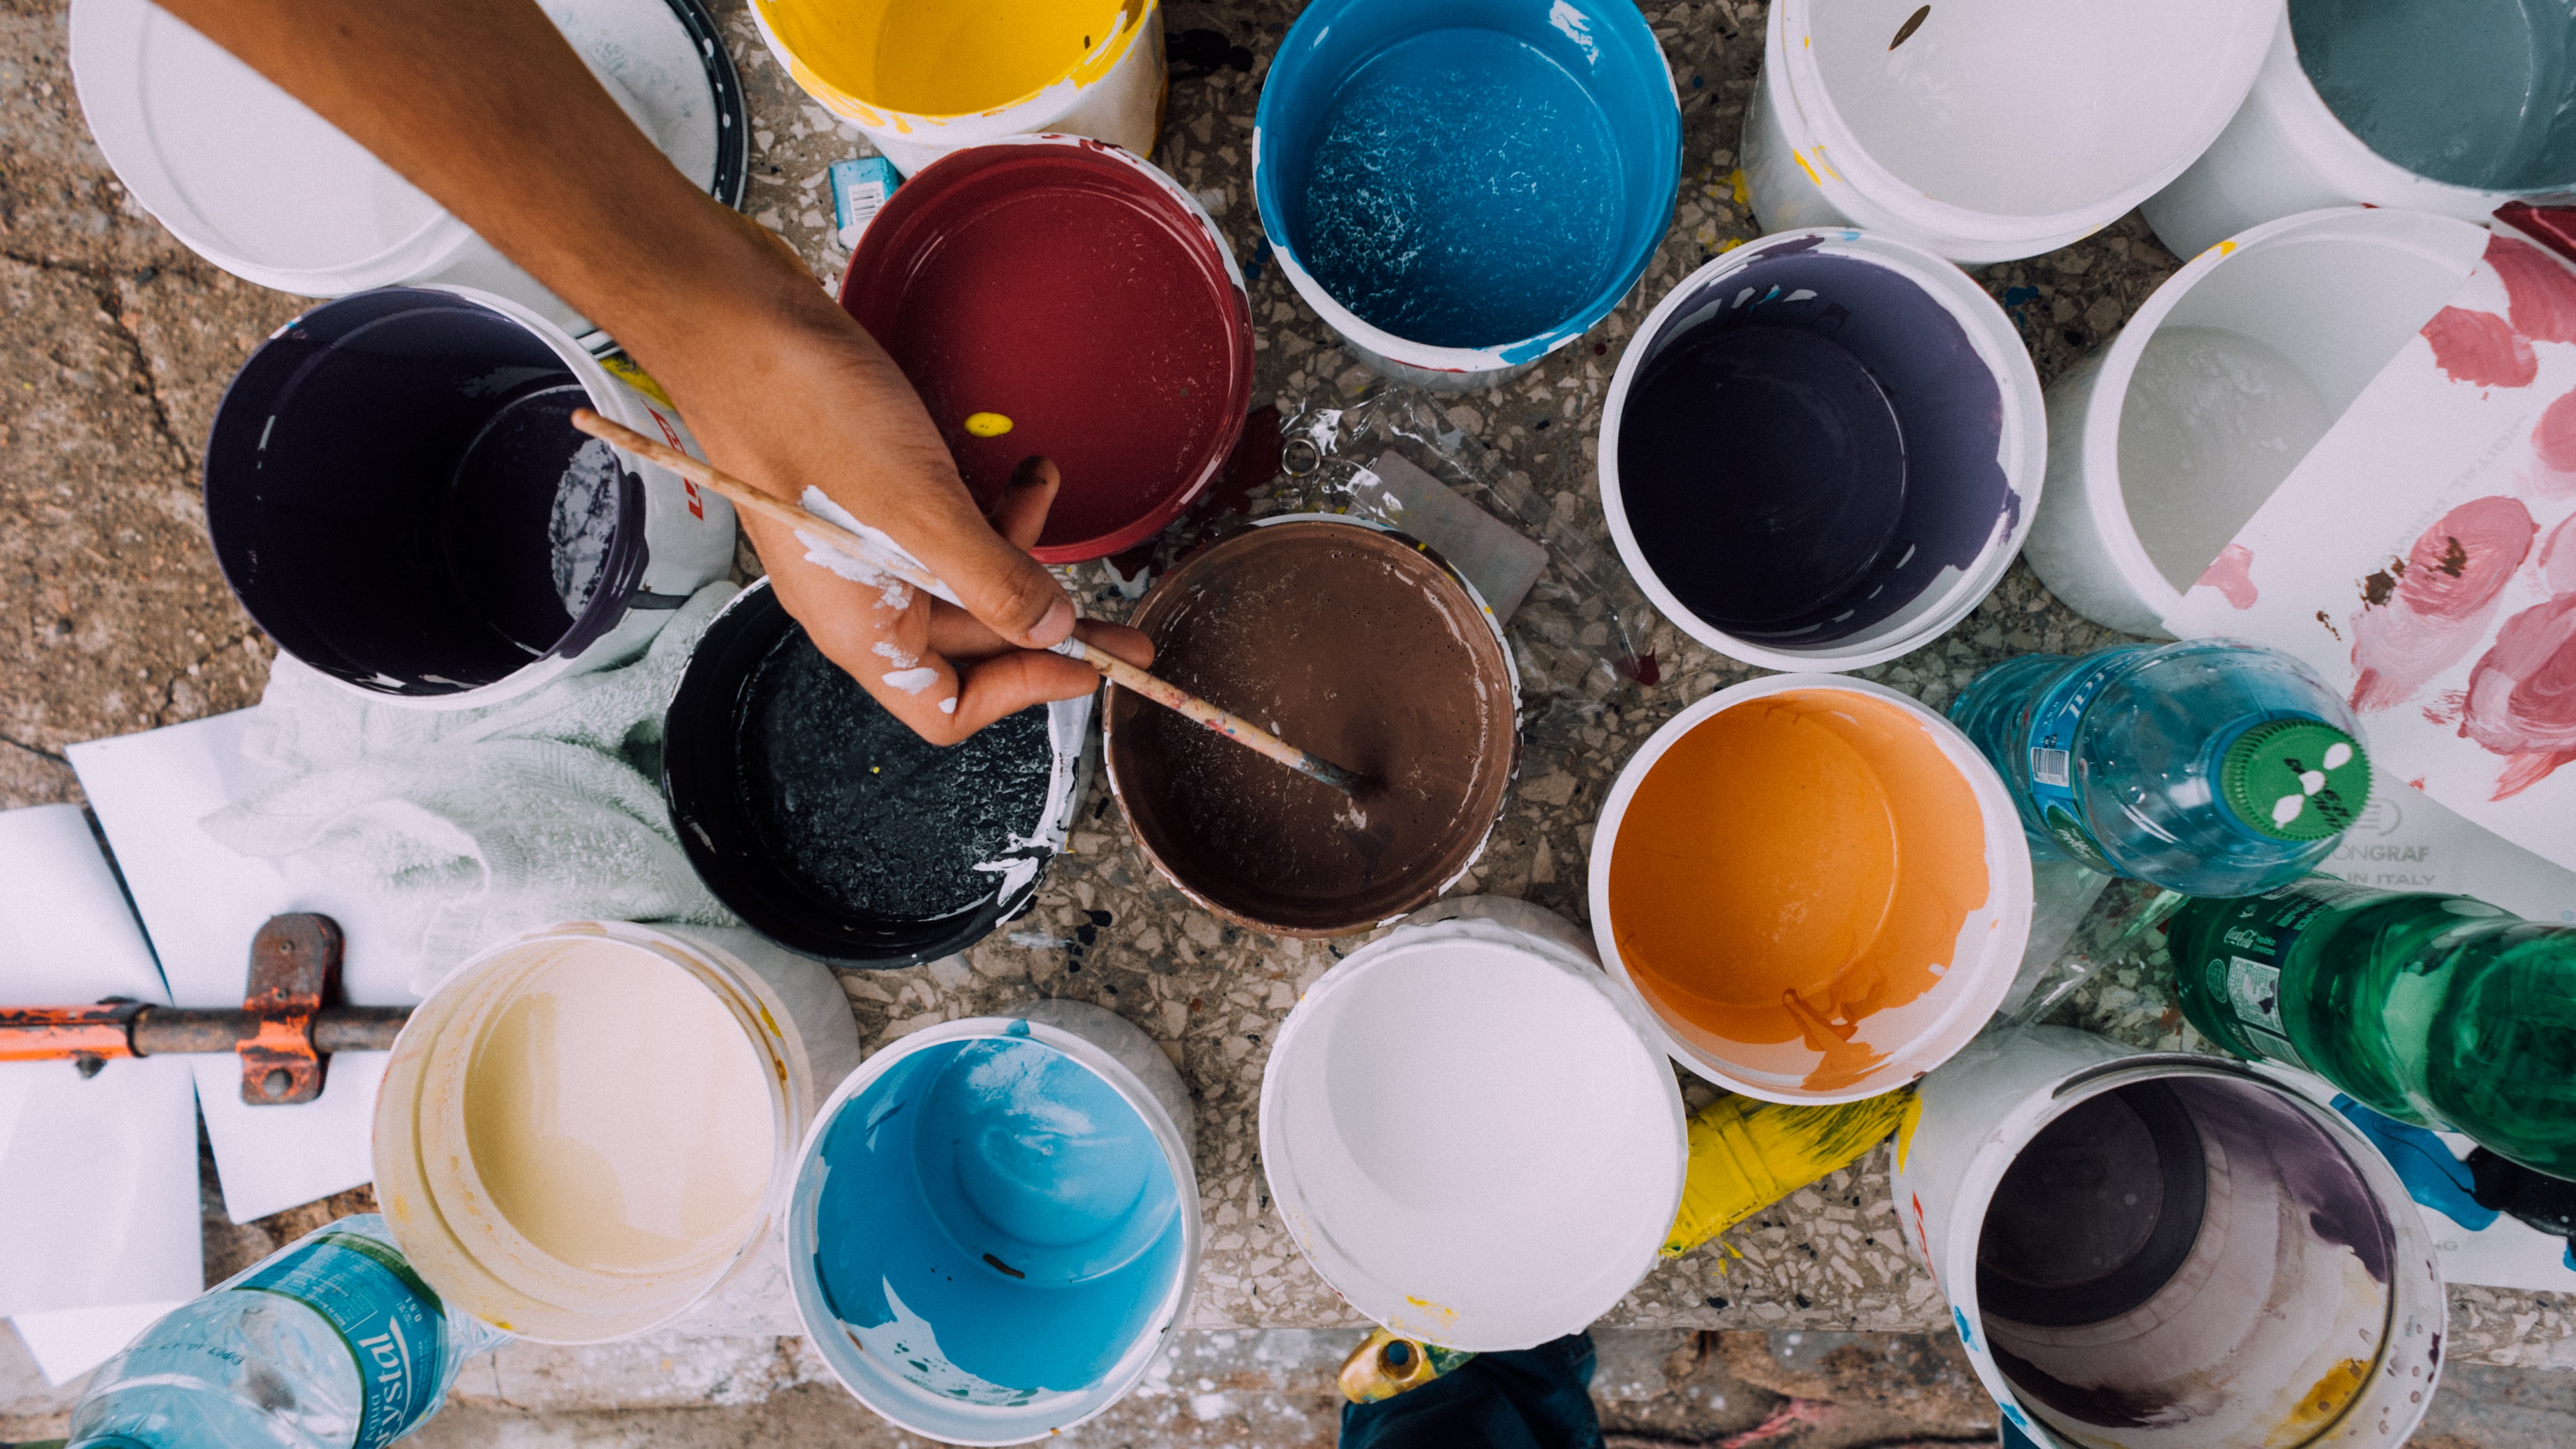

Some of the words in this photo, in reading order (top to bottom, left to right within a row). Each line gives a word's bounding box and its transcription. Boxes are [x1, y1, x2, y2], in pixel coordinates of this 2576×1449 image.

[2332, 844, 2429, 862] ONGRAF
[2347, 873, 2369, 883] IN
[2376, 873, 2437, 886] ITALY
[364, 1395, 380, 1441] Agua
